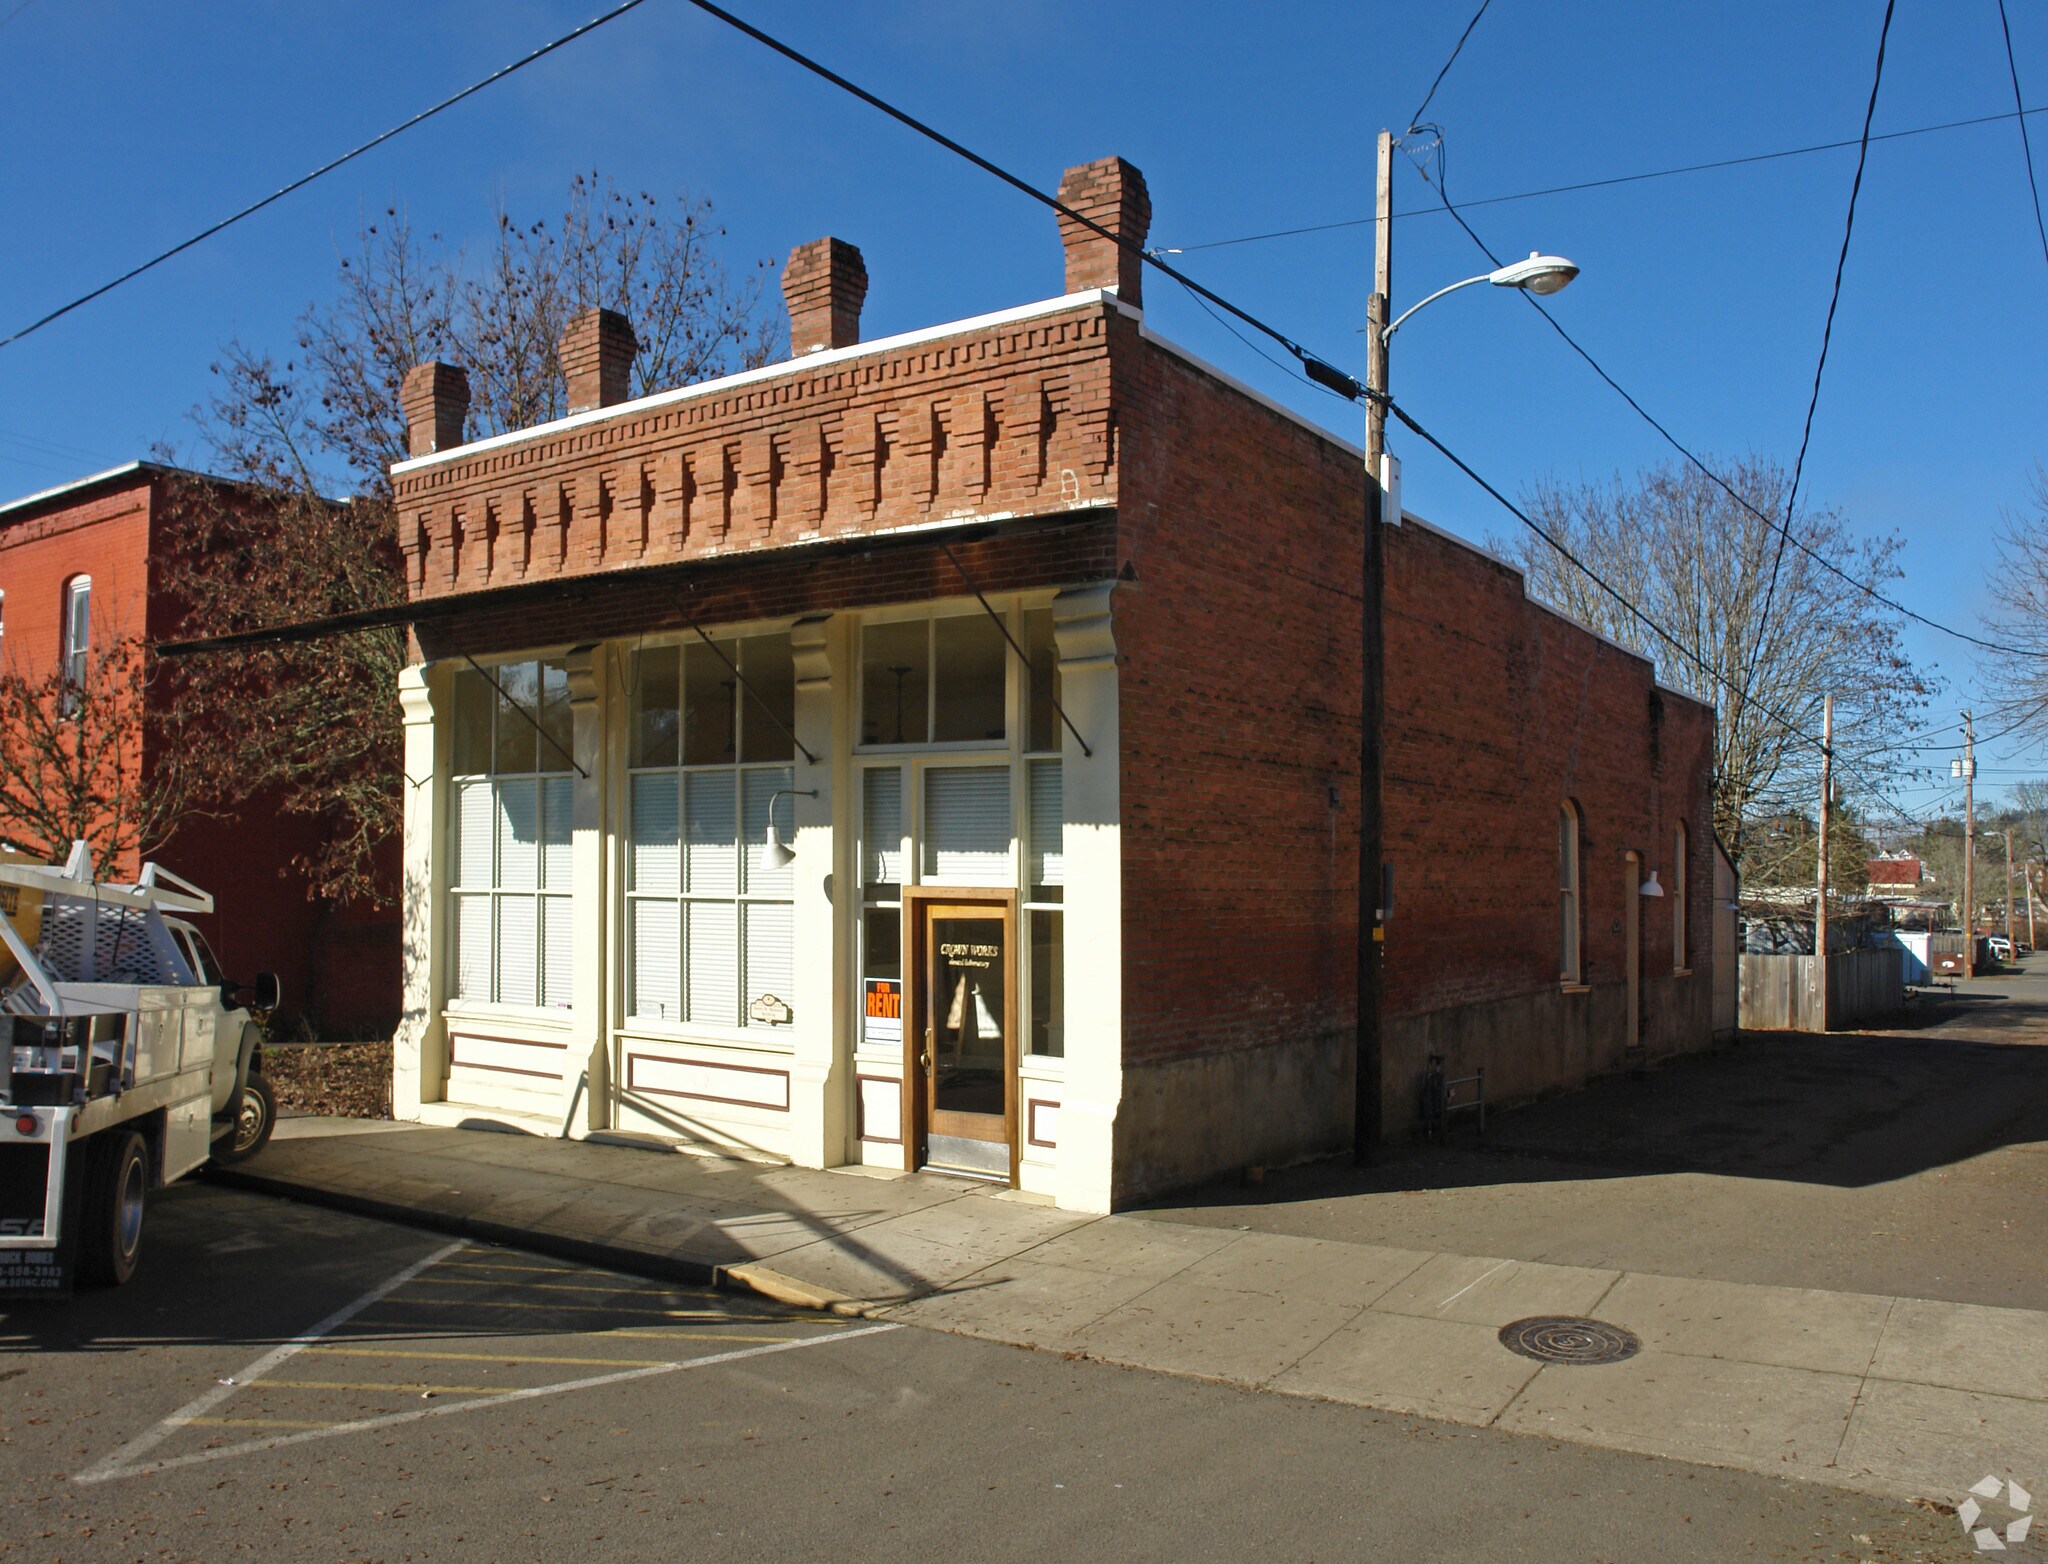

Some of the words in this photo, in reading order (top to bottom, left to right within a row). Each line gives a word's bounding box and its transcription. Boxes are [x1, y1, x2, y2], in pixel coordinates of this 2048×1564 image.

[940, 943, 969, 957] CROWN
[970, 944, 998, 957] WORKS
[876, 982, 890, 993] FOR
[867, 992, 900, 1018] RENT
